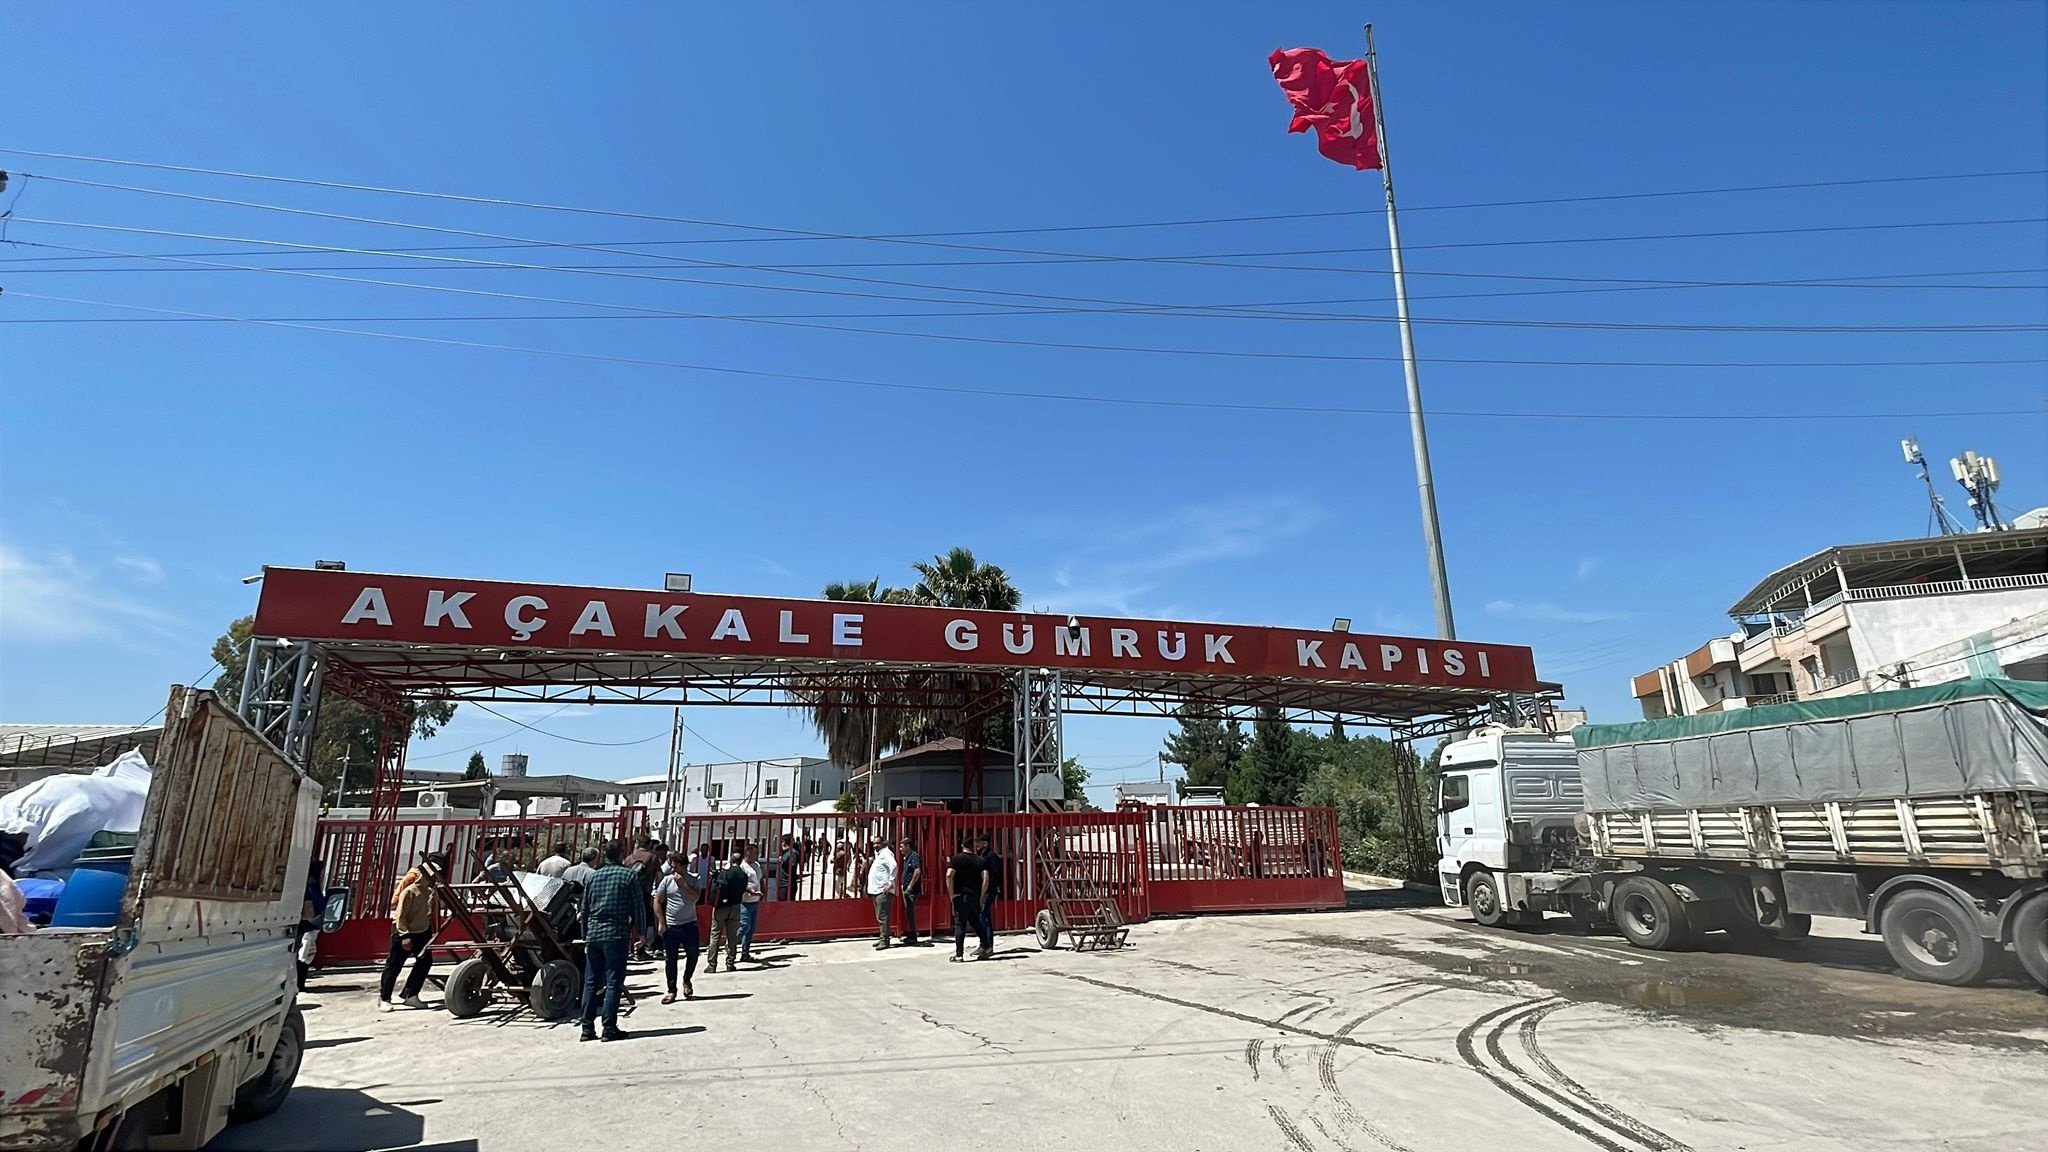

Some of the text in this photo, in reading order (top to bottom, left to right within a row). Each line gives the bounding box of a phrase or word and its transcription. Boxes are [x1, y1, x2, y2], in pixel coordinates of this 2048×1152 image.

[341, 587, 1490, 677] AKÇAKALE GÜMRÜK KAPISI
